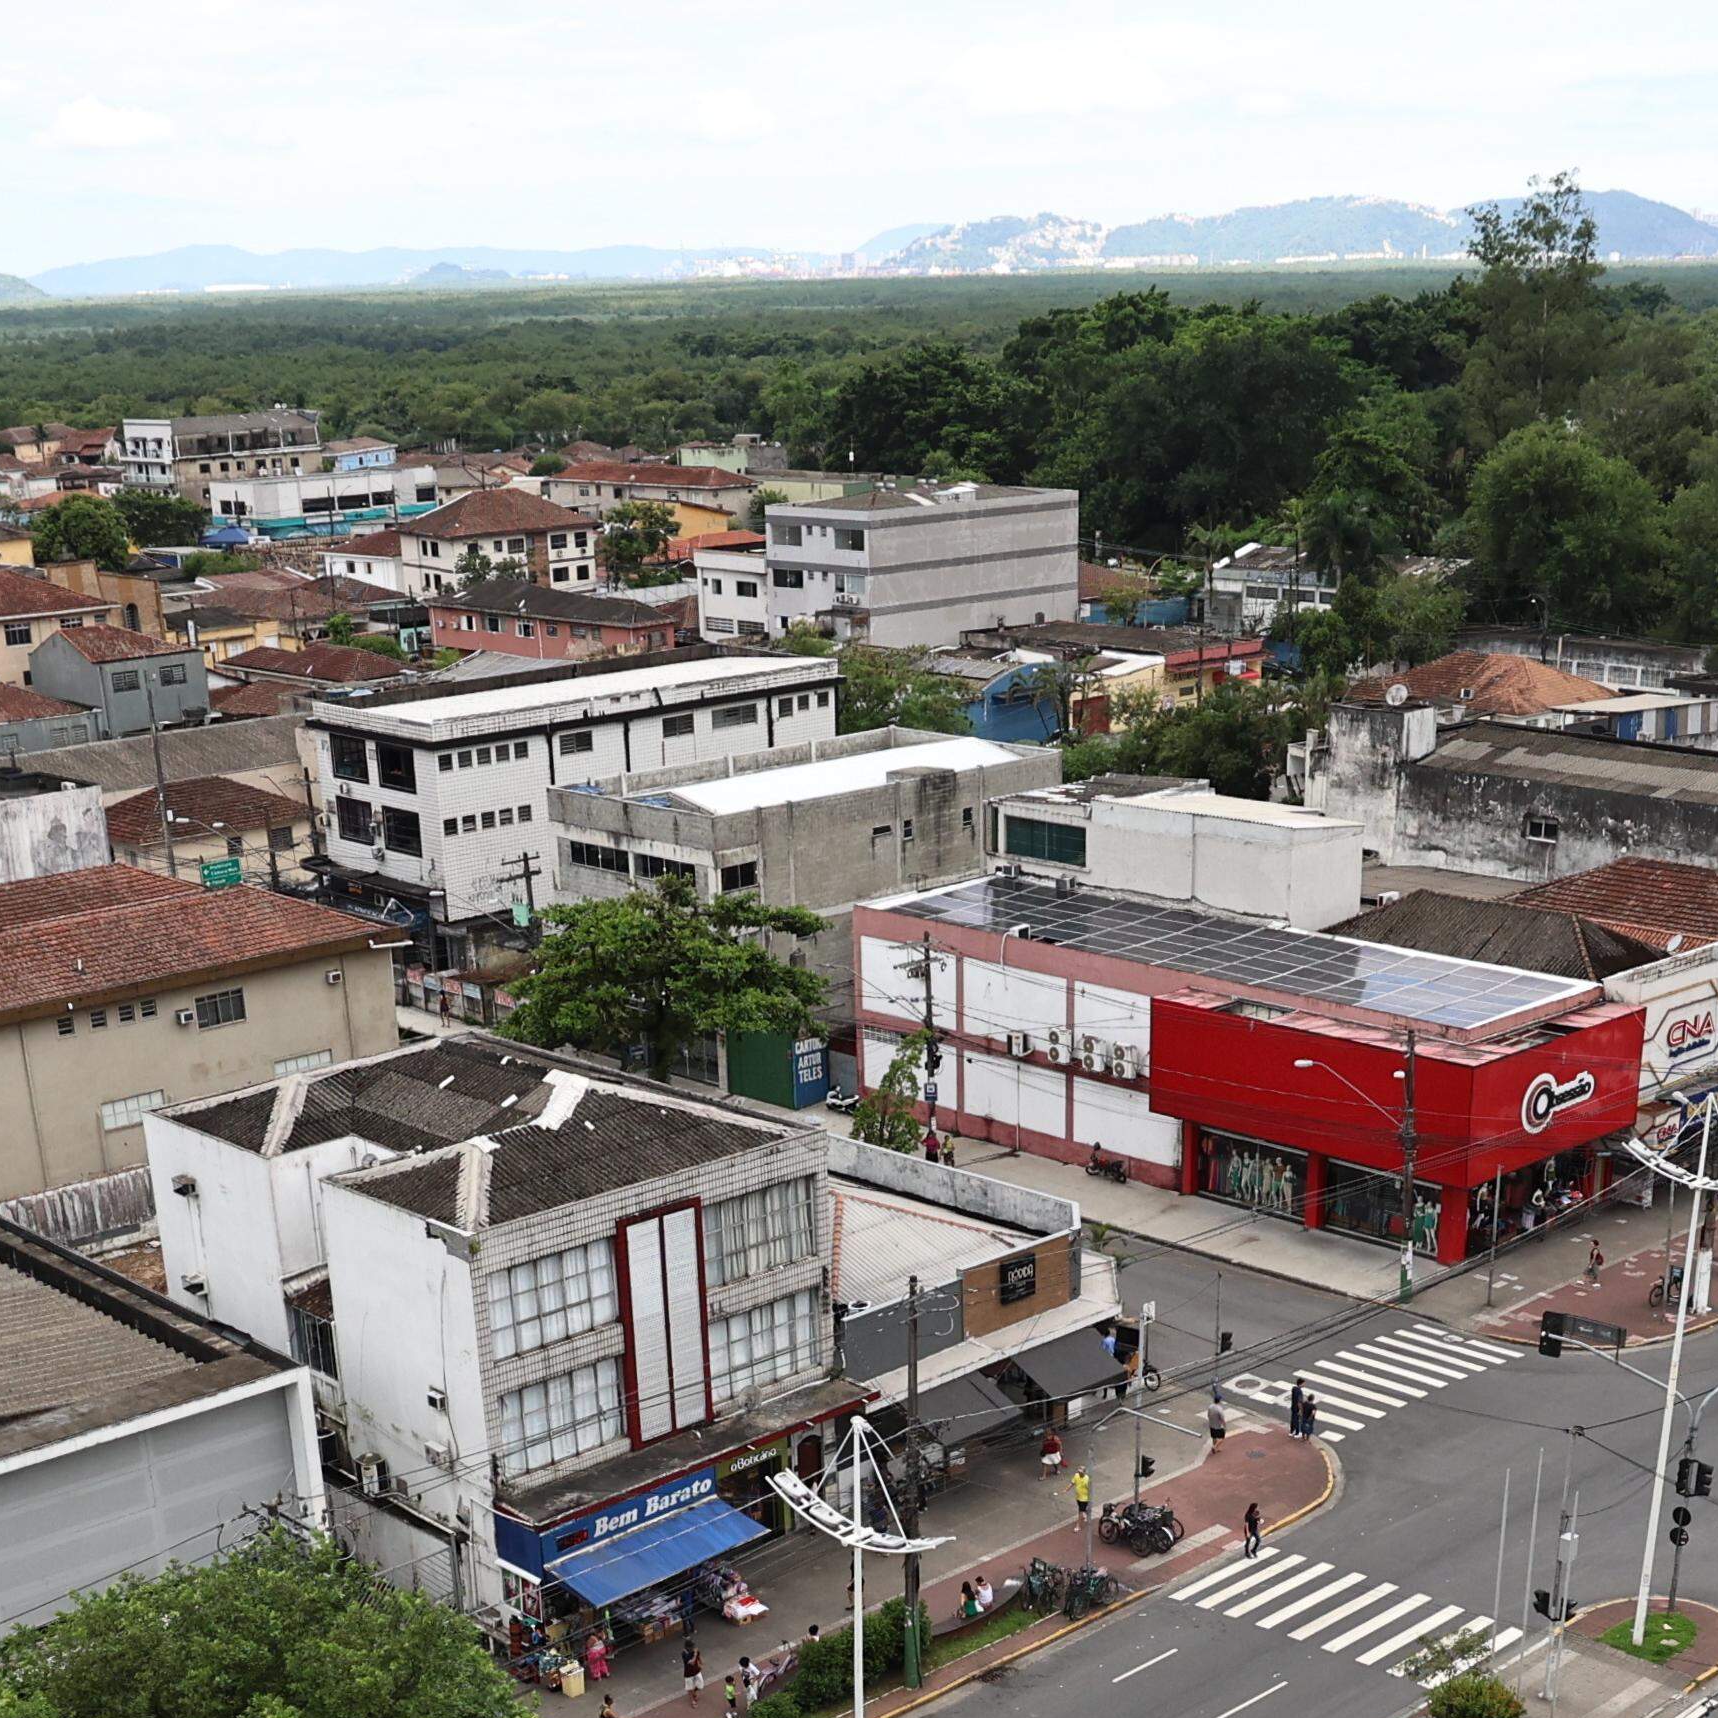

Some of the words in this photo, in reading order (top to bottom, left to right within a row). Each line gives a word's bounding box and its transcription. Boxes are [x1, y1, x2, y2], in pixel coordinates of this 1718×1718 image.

[1667, 1011, 1715, 1048] CNA
[798, 1052, 821, 1070] ARTUR
[798, 1066, 823, 1084] TELES
[593, 1506, 638, 1538] Bem
[645, 1477, 713, 1517] Barato
